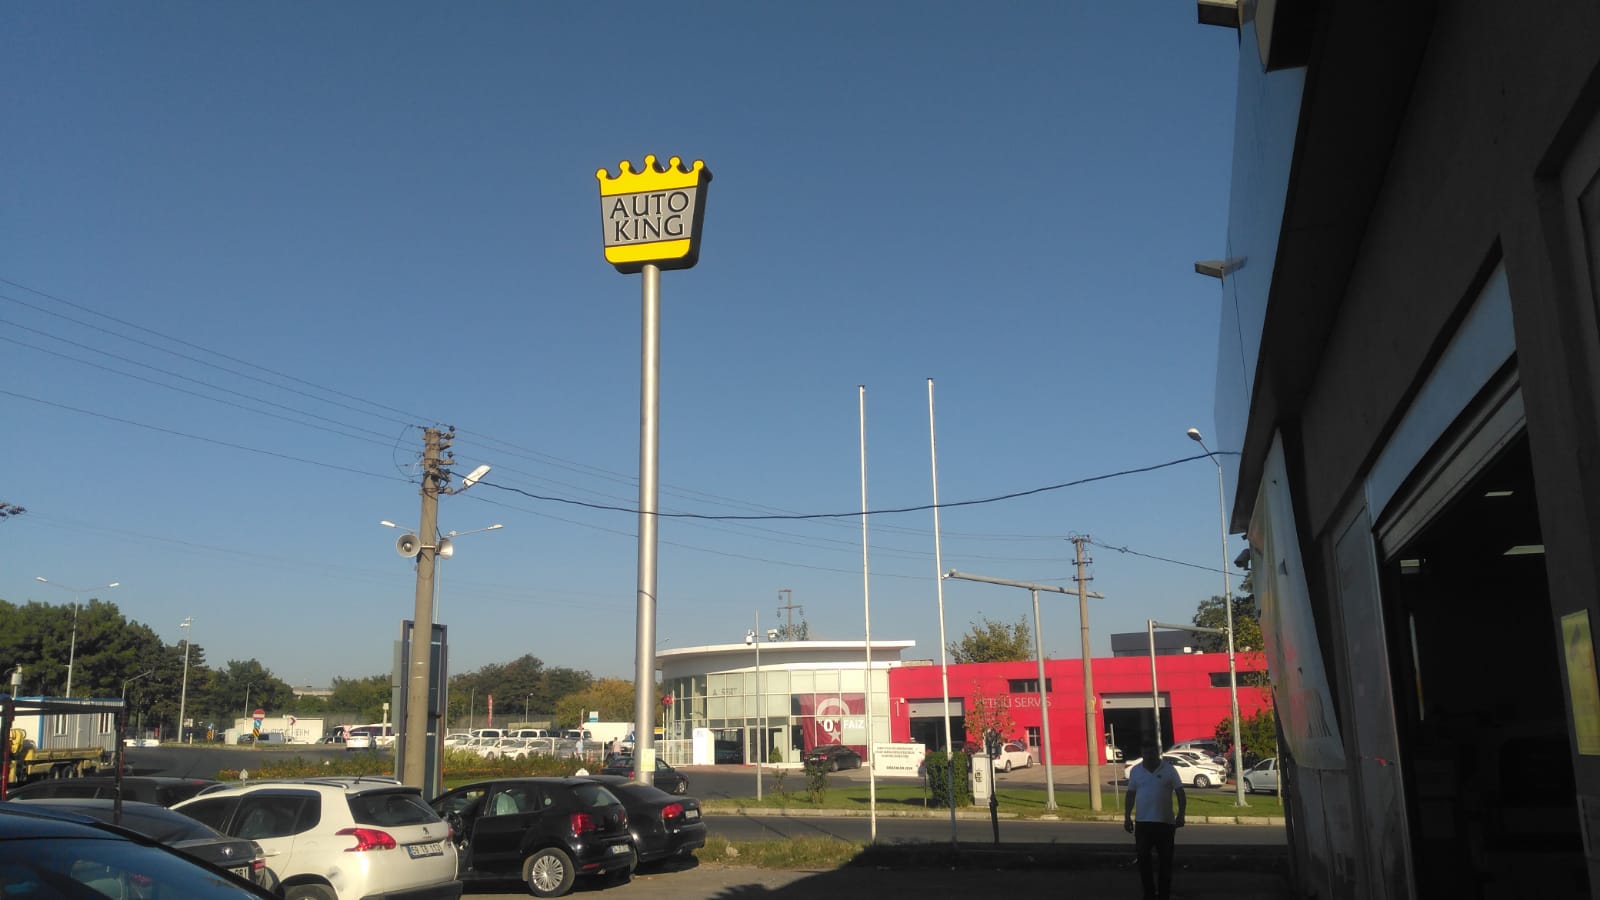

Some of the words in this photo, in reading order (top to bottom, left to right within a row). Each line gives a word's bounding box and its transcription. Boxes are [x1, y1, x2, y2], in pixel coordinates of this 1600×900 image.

[610, 191, 690, 219] AUTO
[615, 215, 685, 242] KING
[1014, 696, 1052, 708] SERVS
